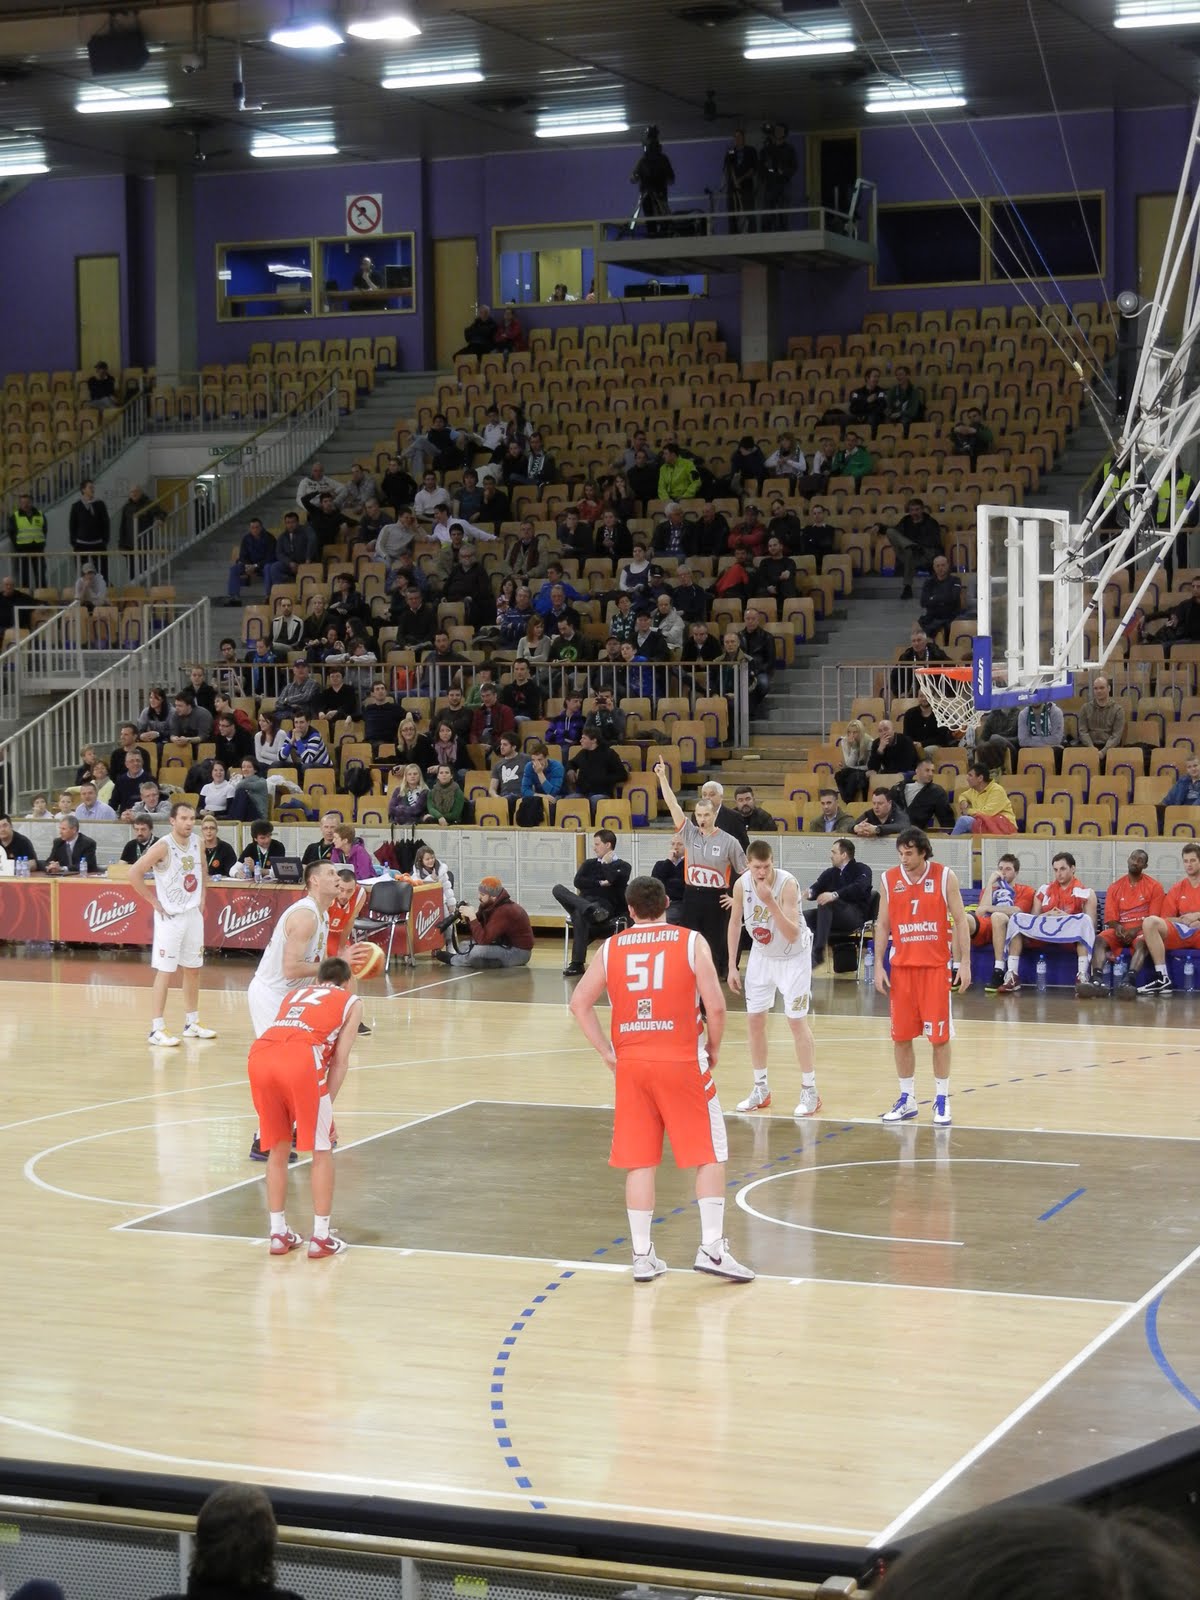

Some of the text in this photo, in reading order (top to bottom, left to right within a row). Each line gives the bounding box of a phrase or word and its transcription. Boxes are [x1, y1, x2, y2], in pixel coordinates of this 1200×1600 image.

[691, 869, 719, 886] KIA
[84, 900, 137, 928] Union
[910, 899, 919, 915] 7
[218, 905, 272, 933] Union
[415, 907, 440, 937] Union
[626, 950, 666, 992] 51
[288, 988, 331, 1005] 12
[792, 994, 807, 1011] 24
